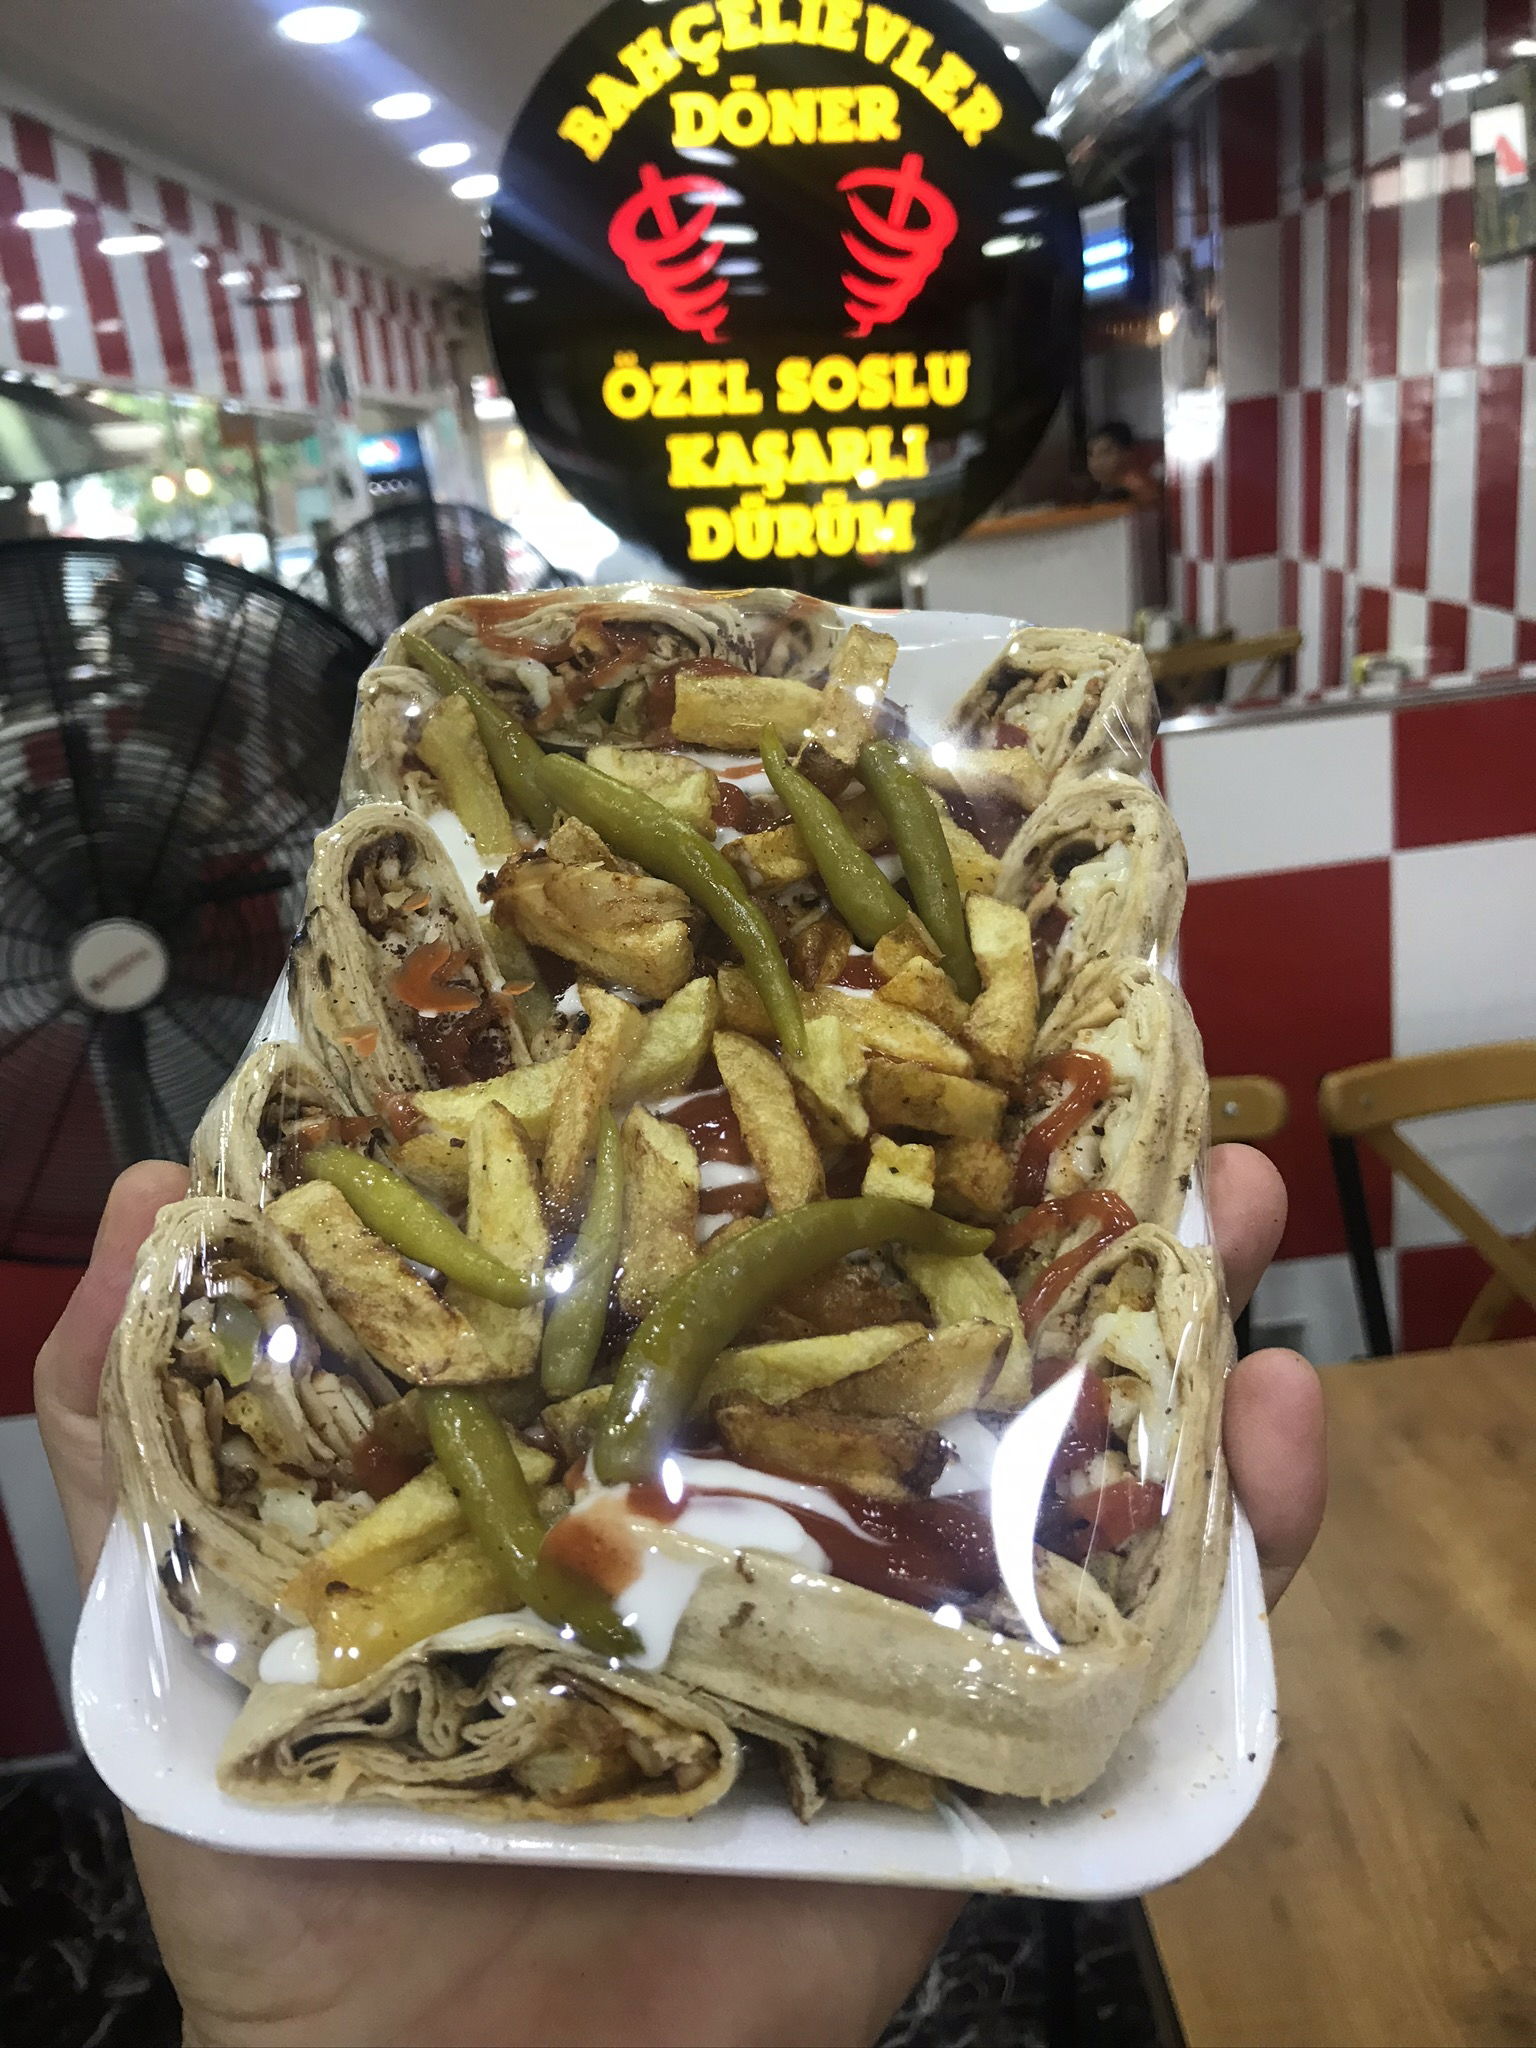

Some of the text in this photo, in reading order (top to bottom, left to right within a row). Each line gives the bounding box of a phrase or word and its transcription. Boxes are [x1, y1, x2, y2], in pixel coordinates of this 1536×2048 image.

[670, 75, 901, 148] DÖNER
[602, 350, 970, 419] ÖZEL SOSLU
[666, 424, 930, 498] KAŞARLI
[685, 489, 917, 561] DÜRÜM
